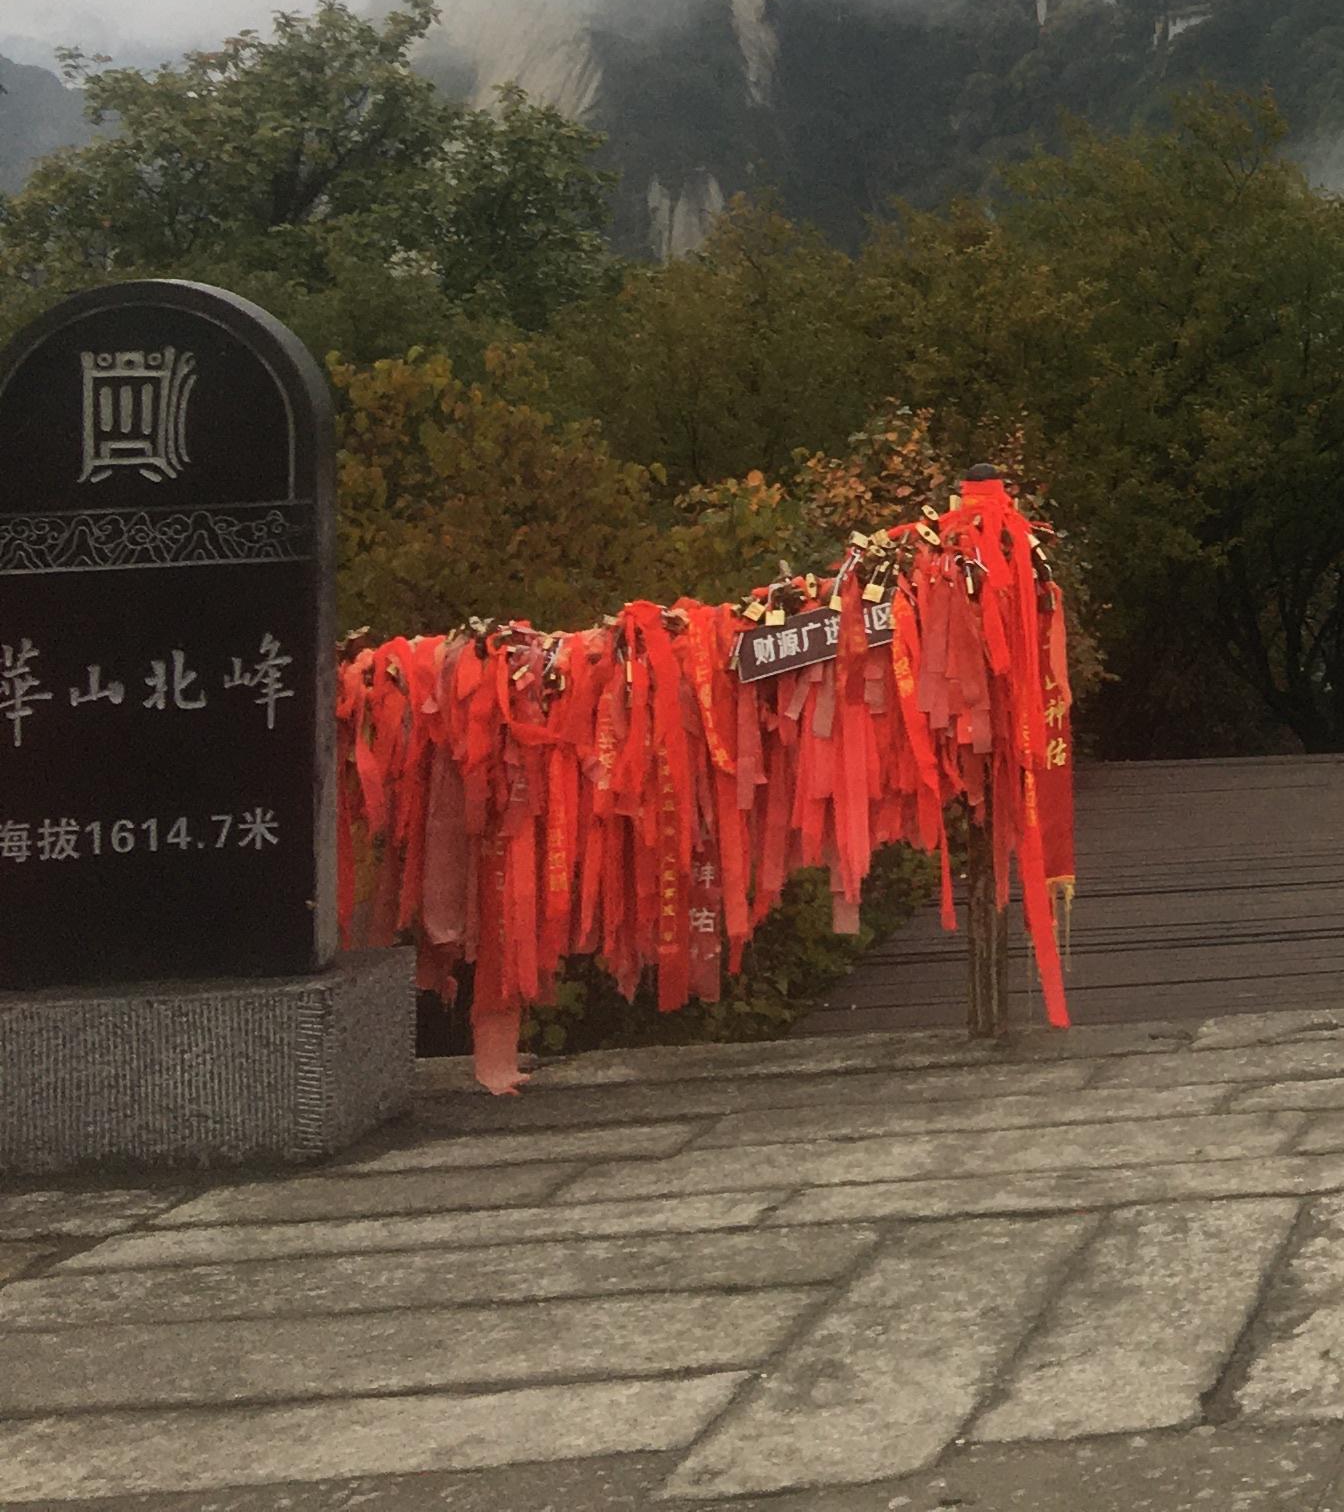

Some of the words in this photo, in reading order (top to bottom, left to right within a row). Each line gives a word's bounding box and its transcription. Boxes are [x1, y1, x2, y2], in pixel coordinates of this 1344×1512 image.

[752, 602, 895, 665] 财源广进区
[0, 807, 279, 862] 海拔1614.7米
